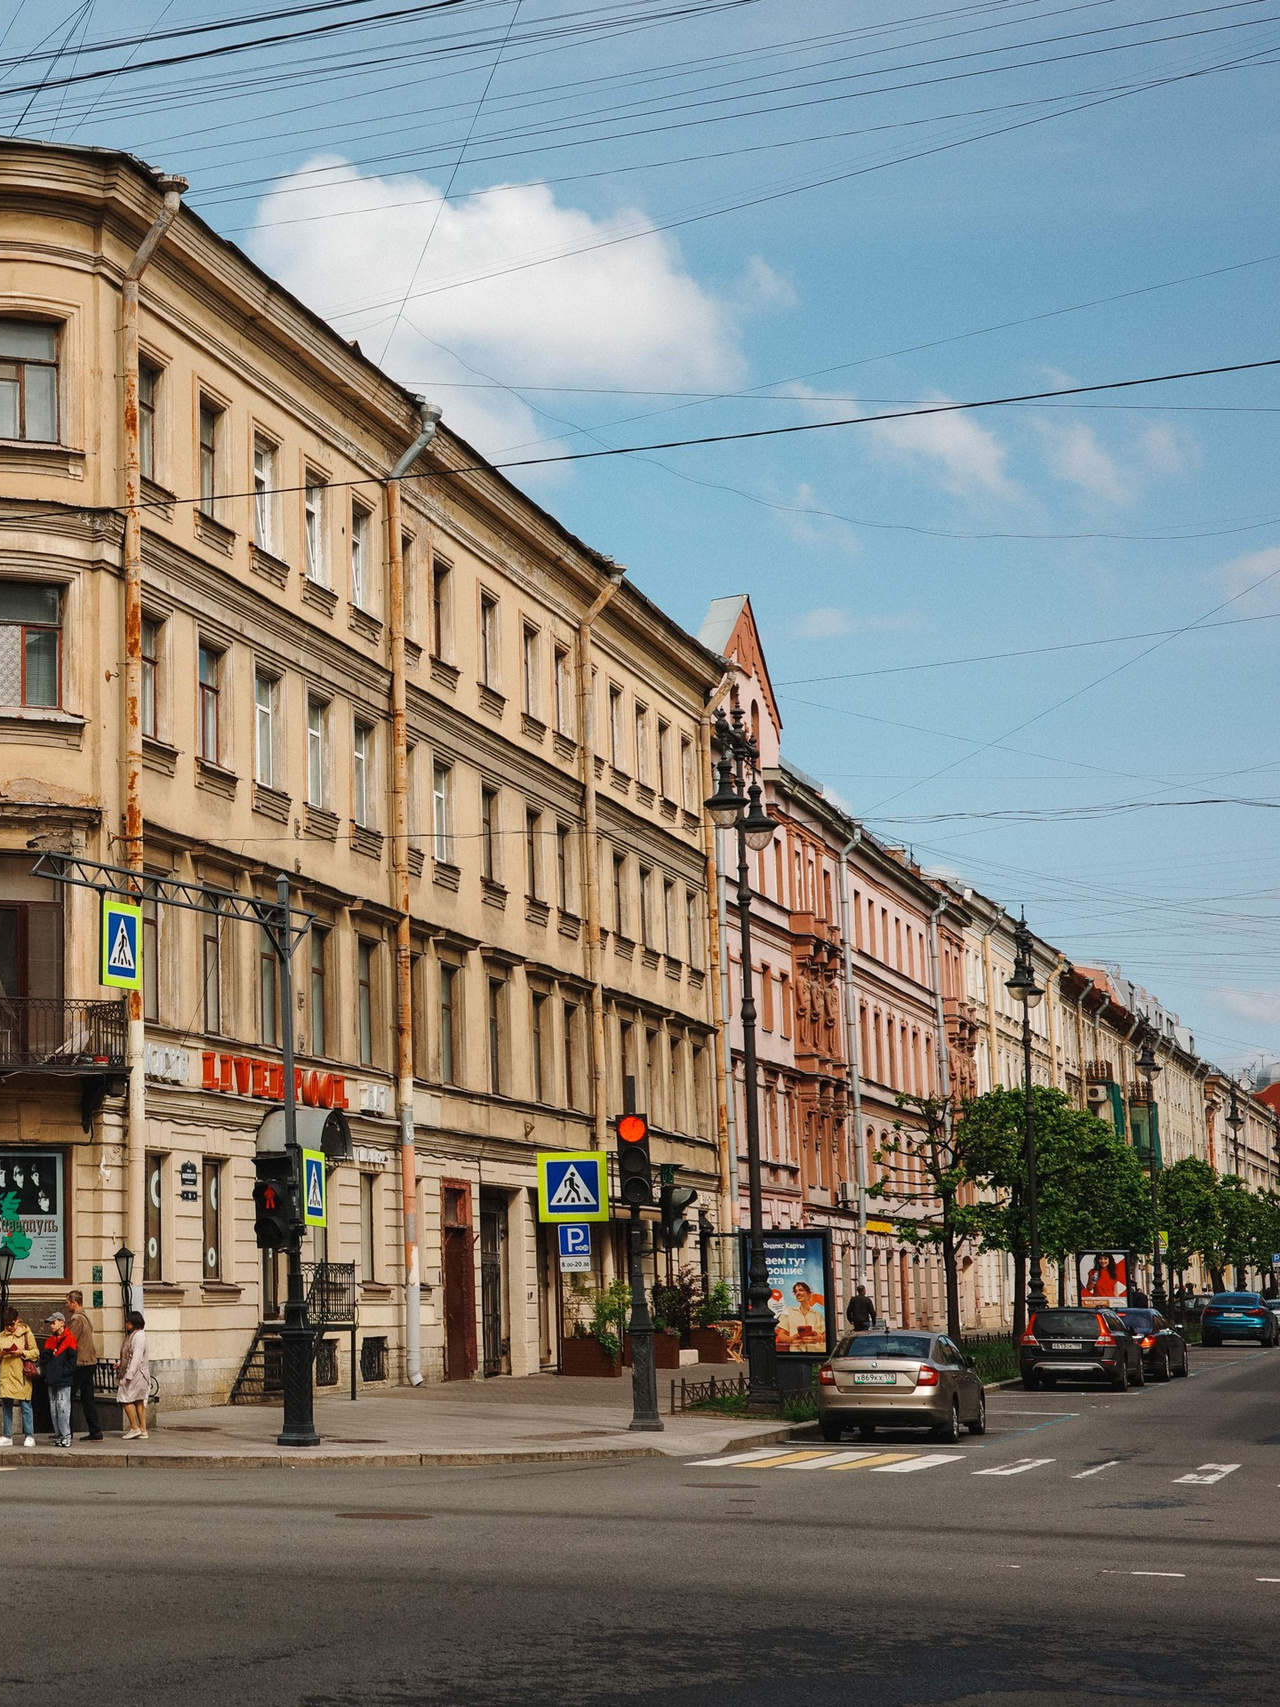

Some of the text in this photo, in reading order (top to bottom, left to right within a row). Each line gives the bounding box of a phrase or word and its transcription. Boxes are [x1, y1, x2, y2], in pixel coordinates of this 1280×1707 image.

[785, 1242, 805, 1250] Карты
[765, 1257, 806, 1267] аем тут
